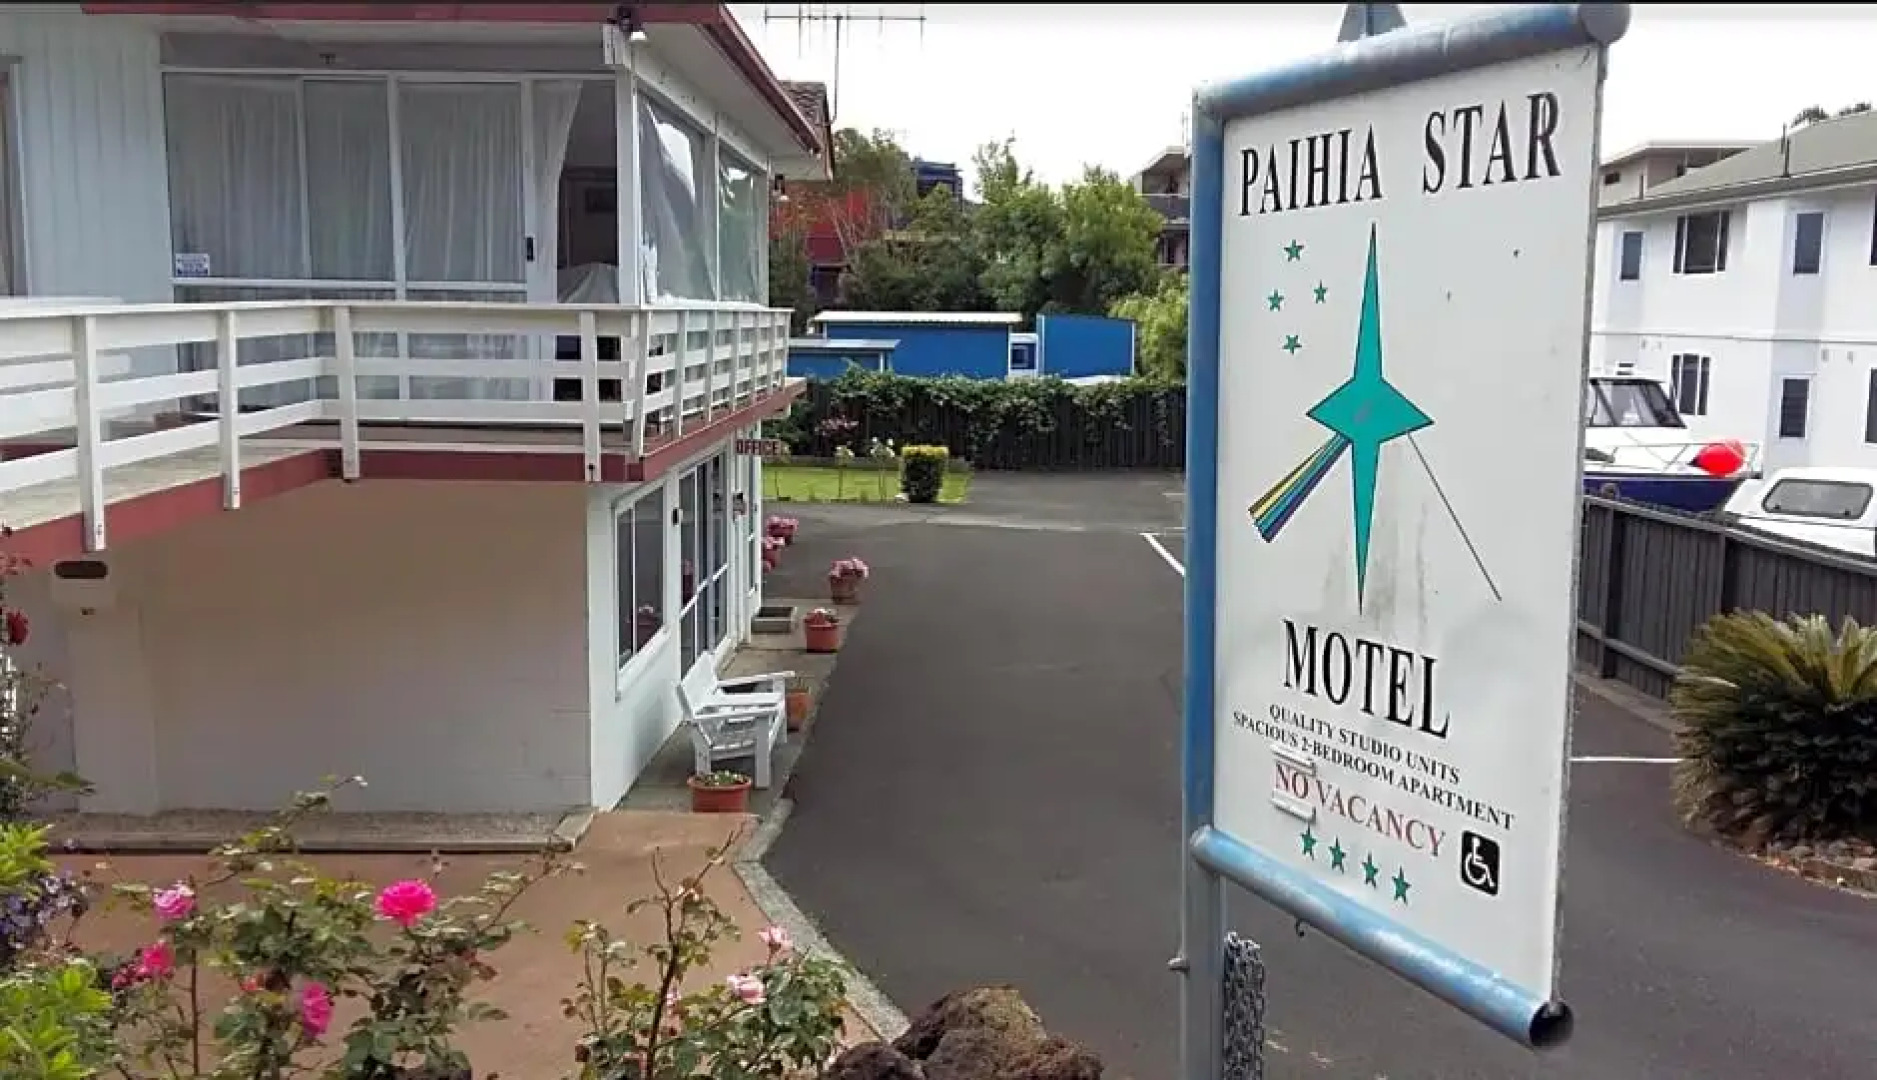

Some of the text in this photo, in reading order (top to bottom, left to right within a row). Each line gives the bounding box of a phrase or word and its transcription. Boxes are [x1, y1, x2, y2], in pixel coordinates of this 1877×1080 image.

[1239, 91, 1562, 217] PAIHIA STAR
[736, 440, 780, 455] OFFICE
[1282, 618, 1450, 739] MOTEL
[1233, 711, 1515, 830] SPACIOUS 2-BEDROOM APARTMENT
[1269, 704, 1460, 785] QUALITY STUDIO UNITS
[1275, 761, 1446, 857] NO VACANCY
